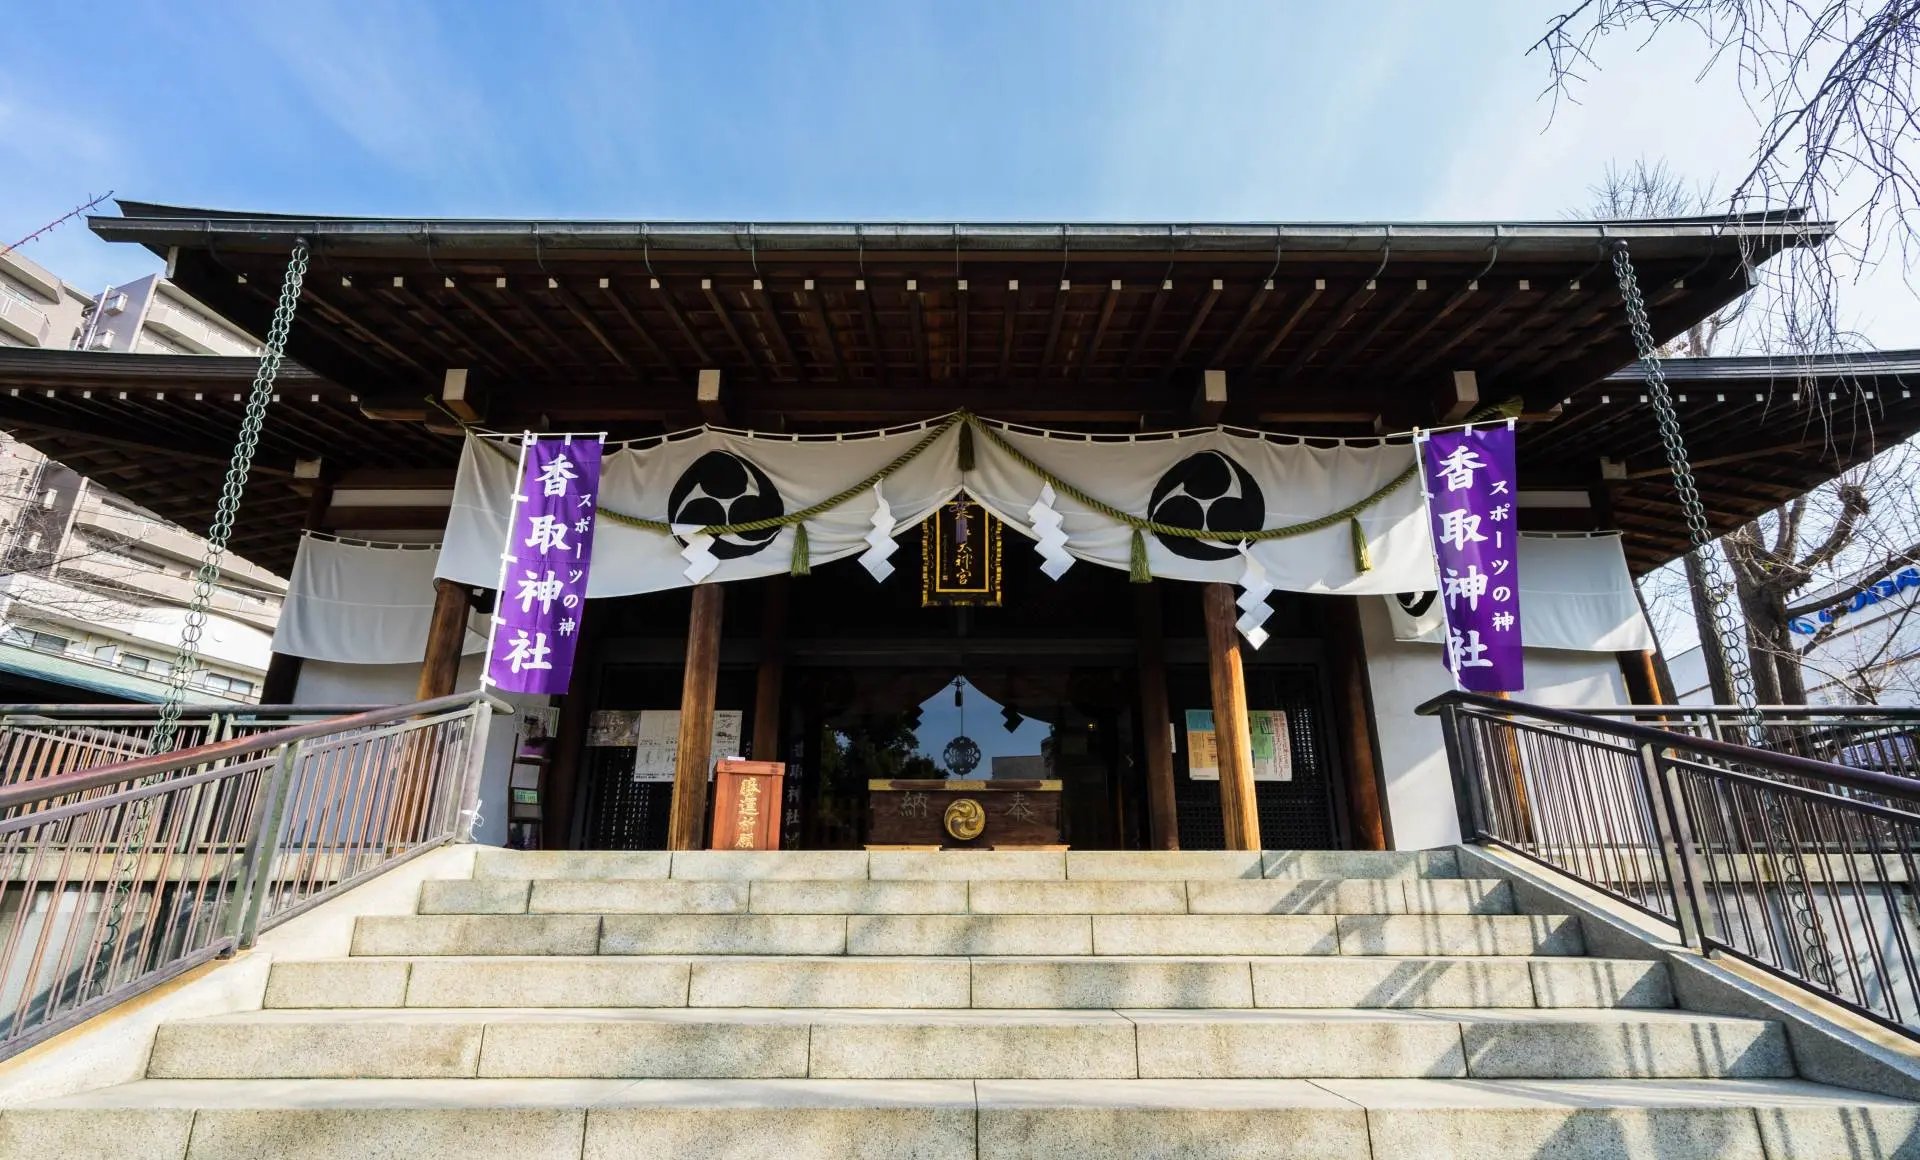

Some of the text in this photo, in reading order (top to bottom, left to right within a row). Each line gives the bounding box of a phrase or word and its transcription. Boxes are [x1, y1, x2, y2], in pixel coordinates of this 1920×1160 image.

[503, 453, 579, 674] 香取神社
[558, 493, 592, 636] スポーツの神
[1435, 445, 1494, 671] 香取神社
[1489, 480, 1515, 632] スポーツの神
